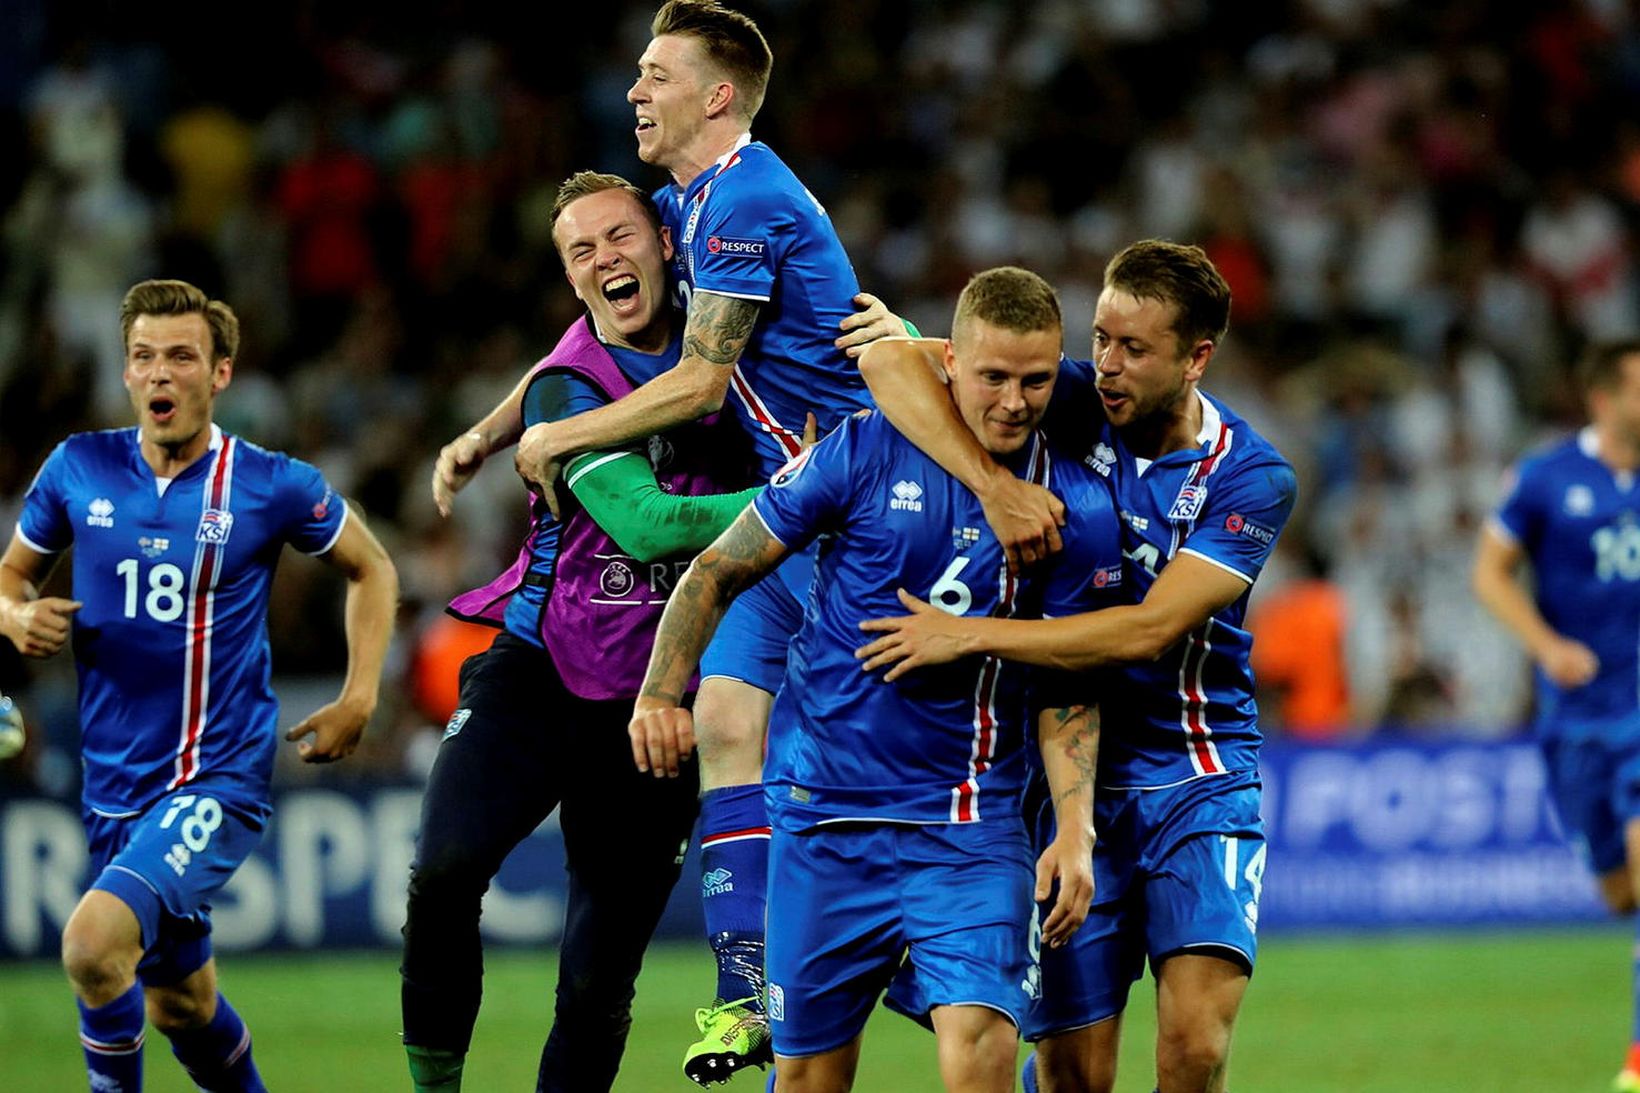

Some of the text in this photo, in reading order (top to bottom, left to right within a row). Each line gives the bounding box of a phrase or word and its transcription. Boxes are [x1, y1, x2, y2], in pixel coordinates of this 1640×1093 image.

[721, 241, 765, 253] RESPECT
[116, 558, 185, 623] 18
[929, 556, 972, 616] 6
[160, 795, 223, 853] 18
[1219, 834, 1267, 904] 14
